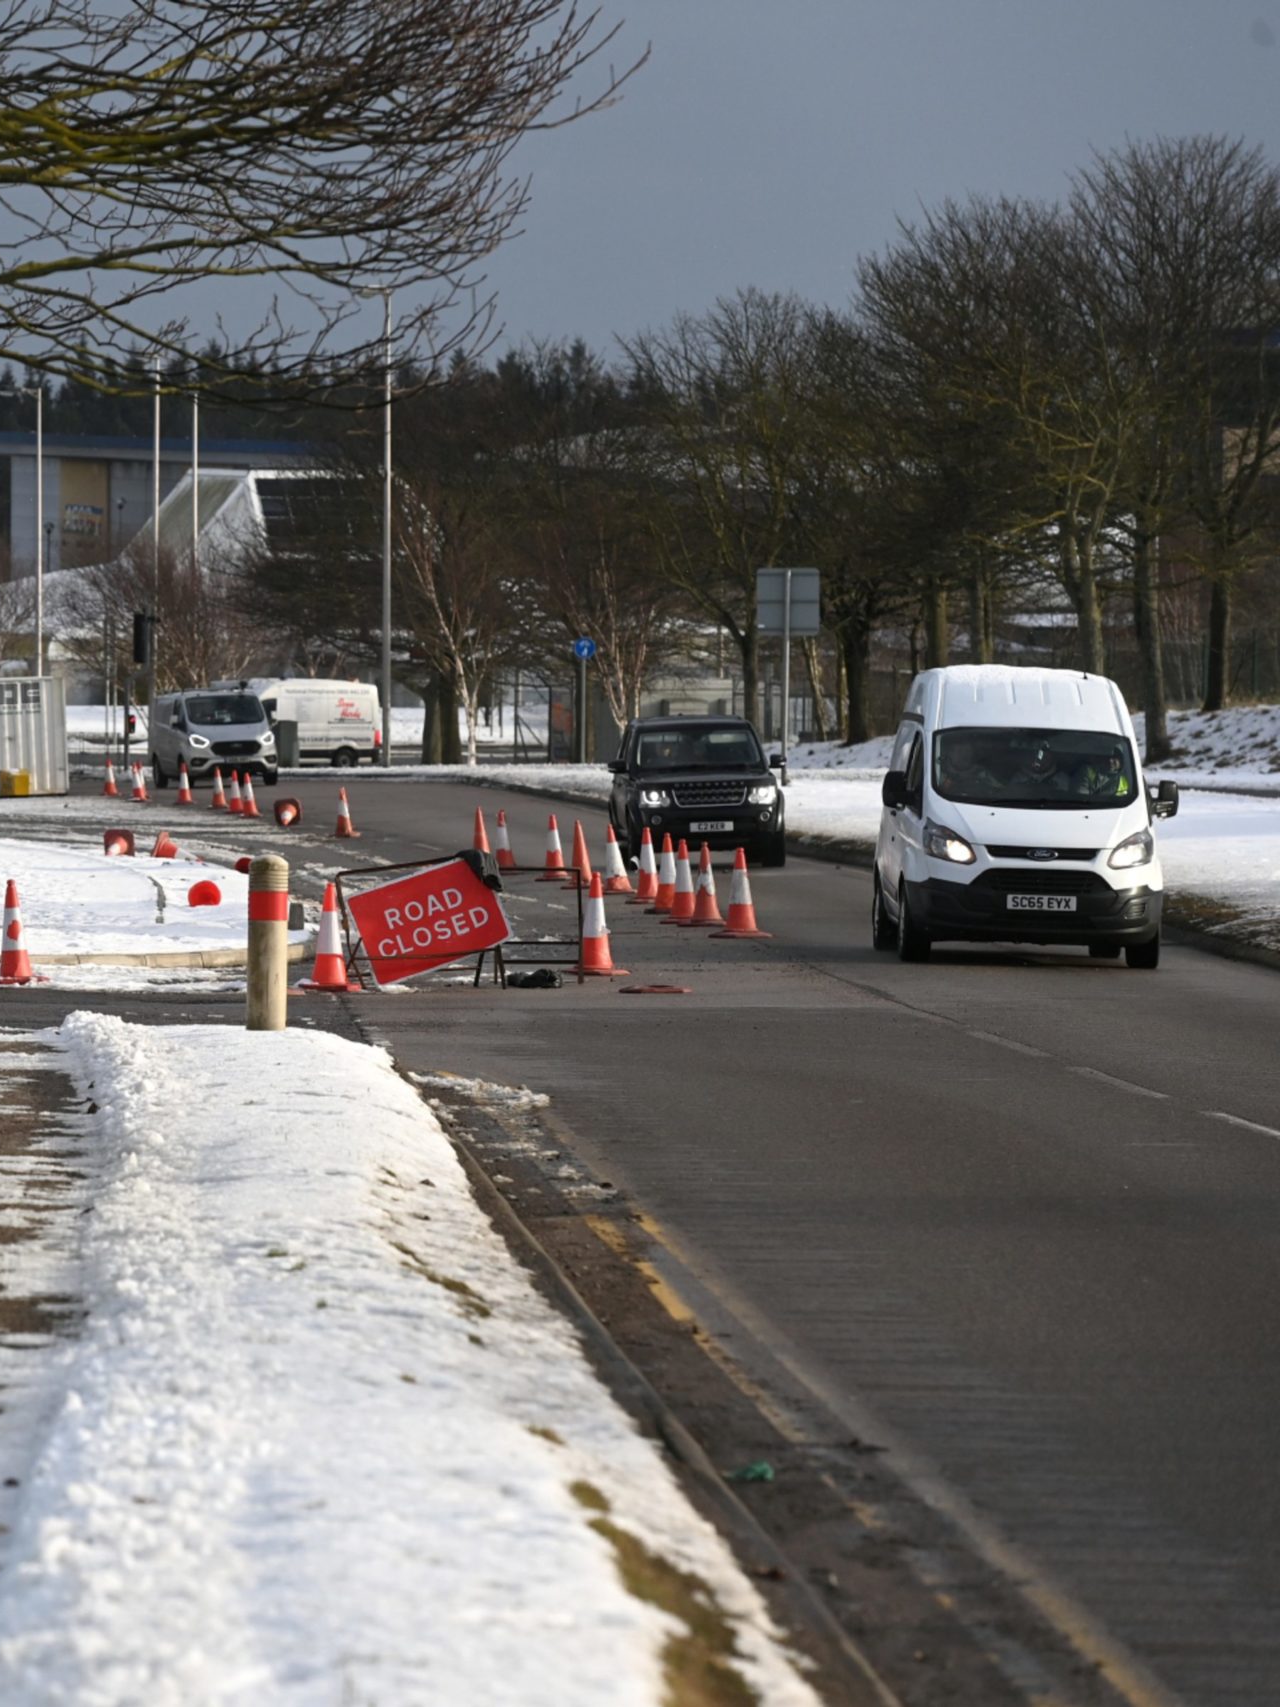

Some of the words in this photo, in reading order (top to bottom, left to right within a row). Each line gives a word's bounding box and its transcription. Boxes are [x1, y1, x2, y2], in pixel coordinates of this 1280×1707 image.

[383, 887, 463, 930] ROAD
[1011, 895, 1044, 909] SC65
[1047, 896, 1071, 910] EYX
[377, 906, 489, 958] CLOSED
